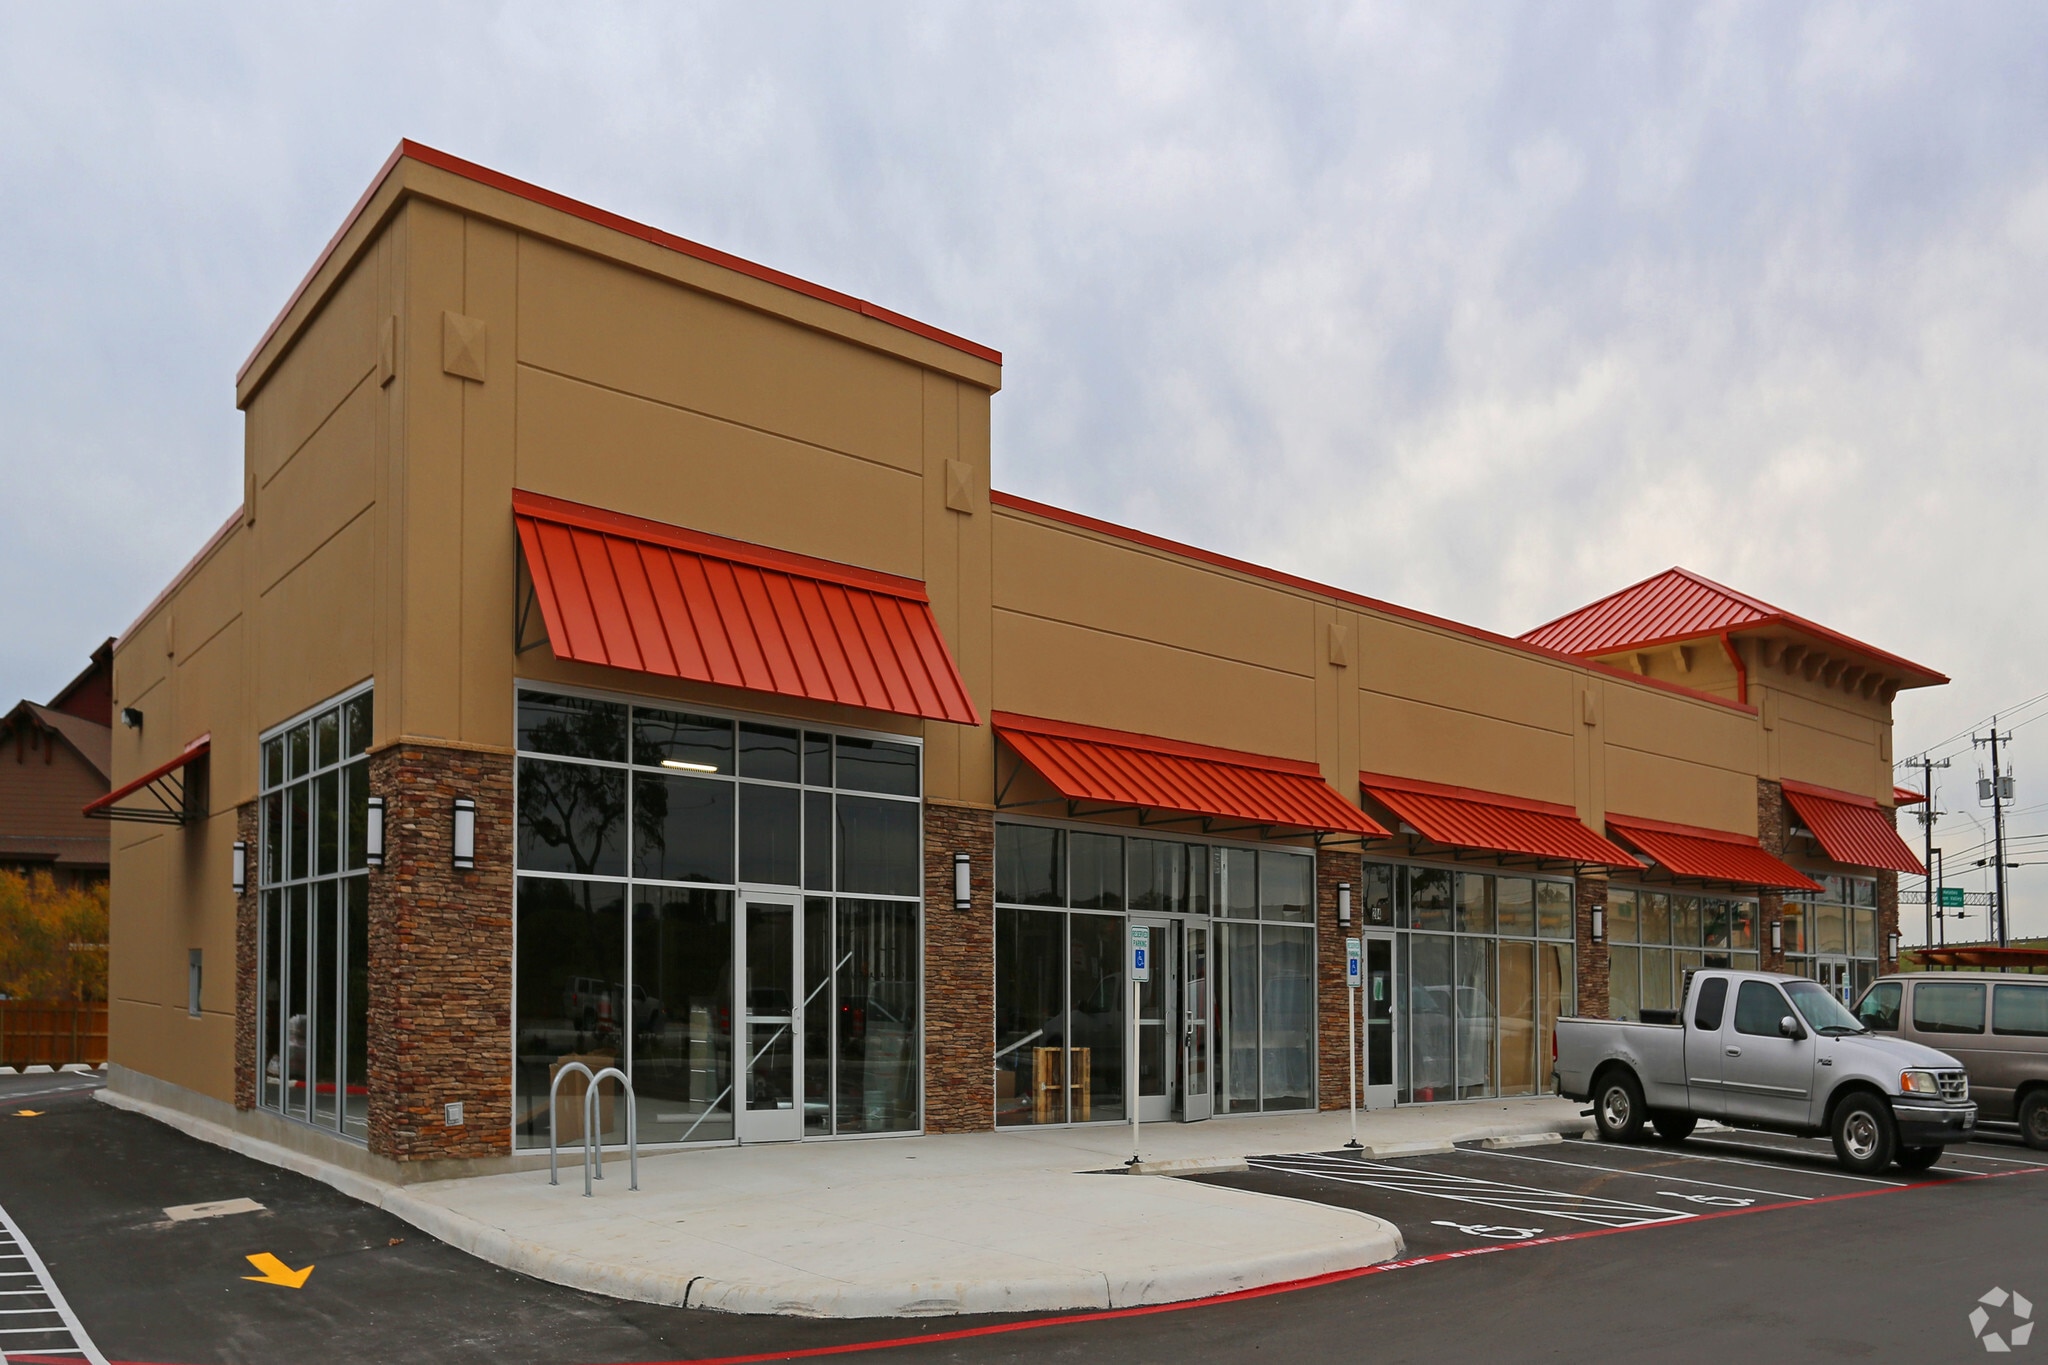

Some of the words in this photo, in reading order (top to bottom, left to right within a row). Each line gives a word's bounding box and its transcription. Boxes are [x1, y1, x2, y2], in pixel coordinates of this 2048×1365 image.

[1131, 930, 1149, 938] RESERVED
[1133, 939, 1147, 947] PARKING
[1402, 1258, 1434, 1267] LANE
